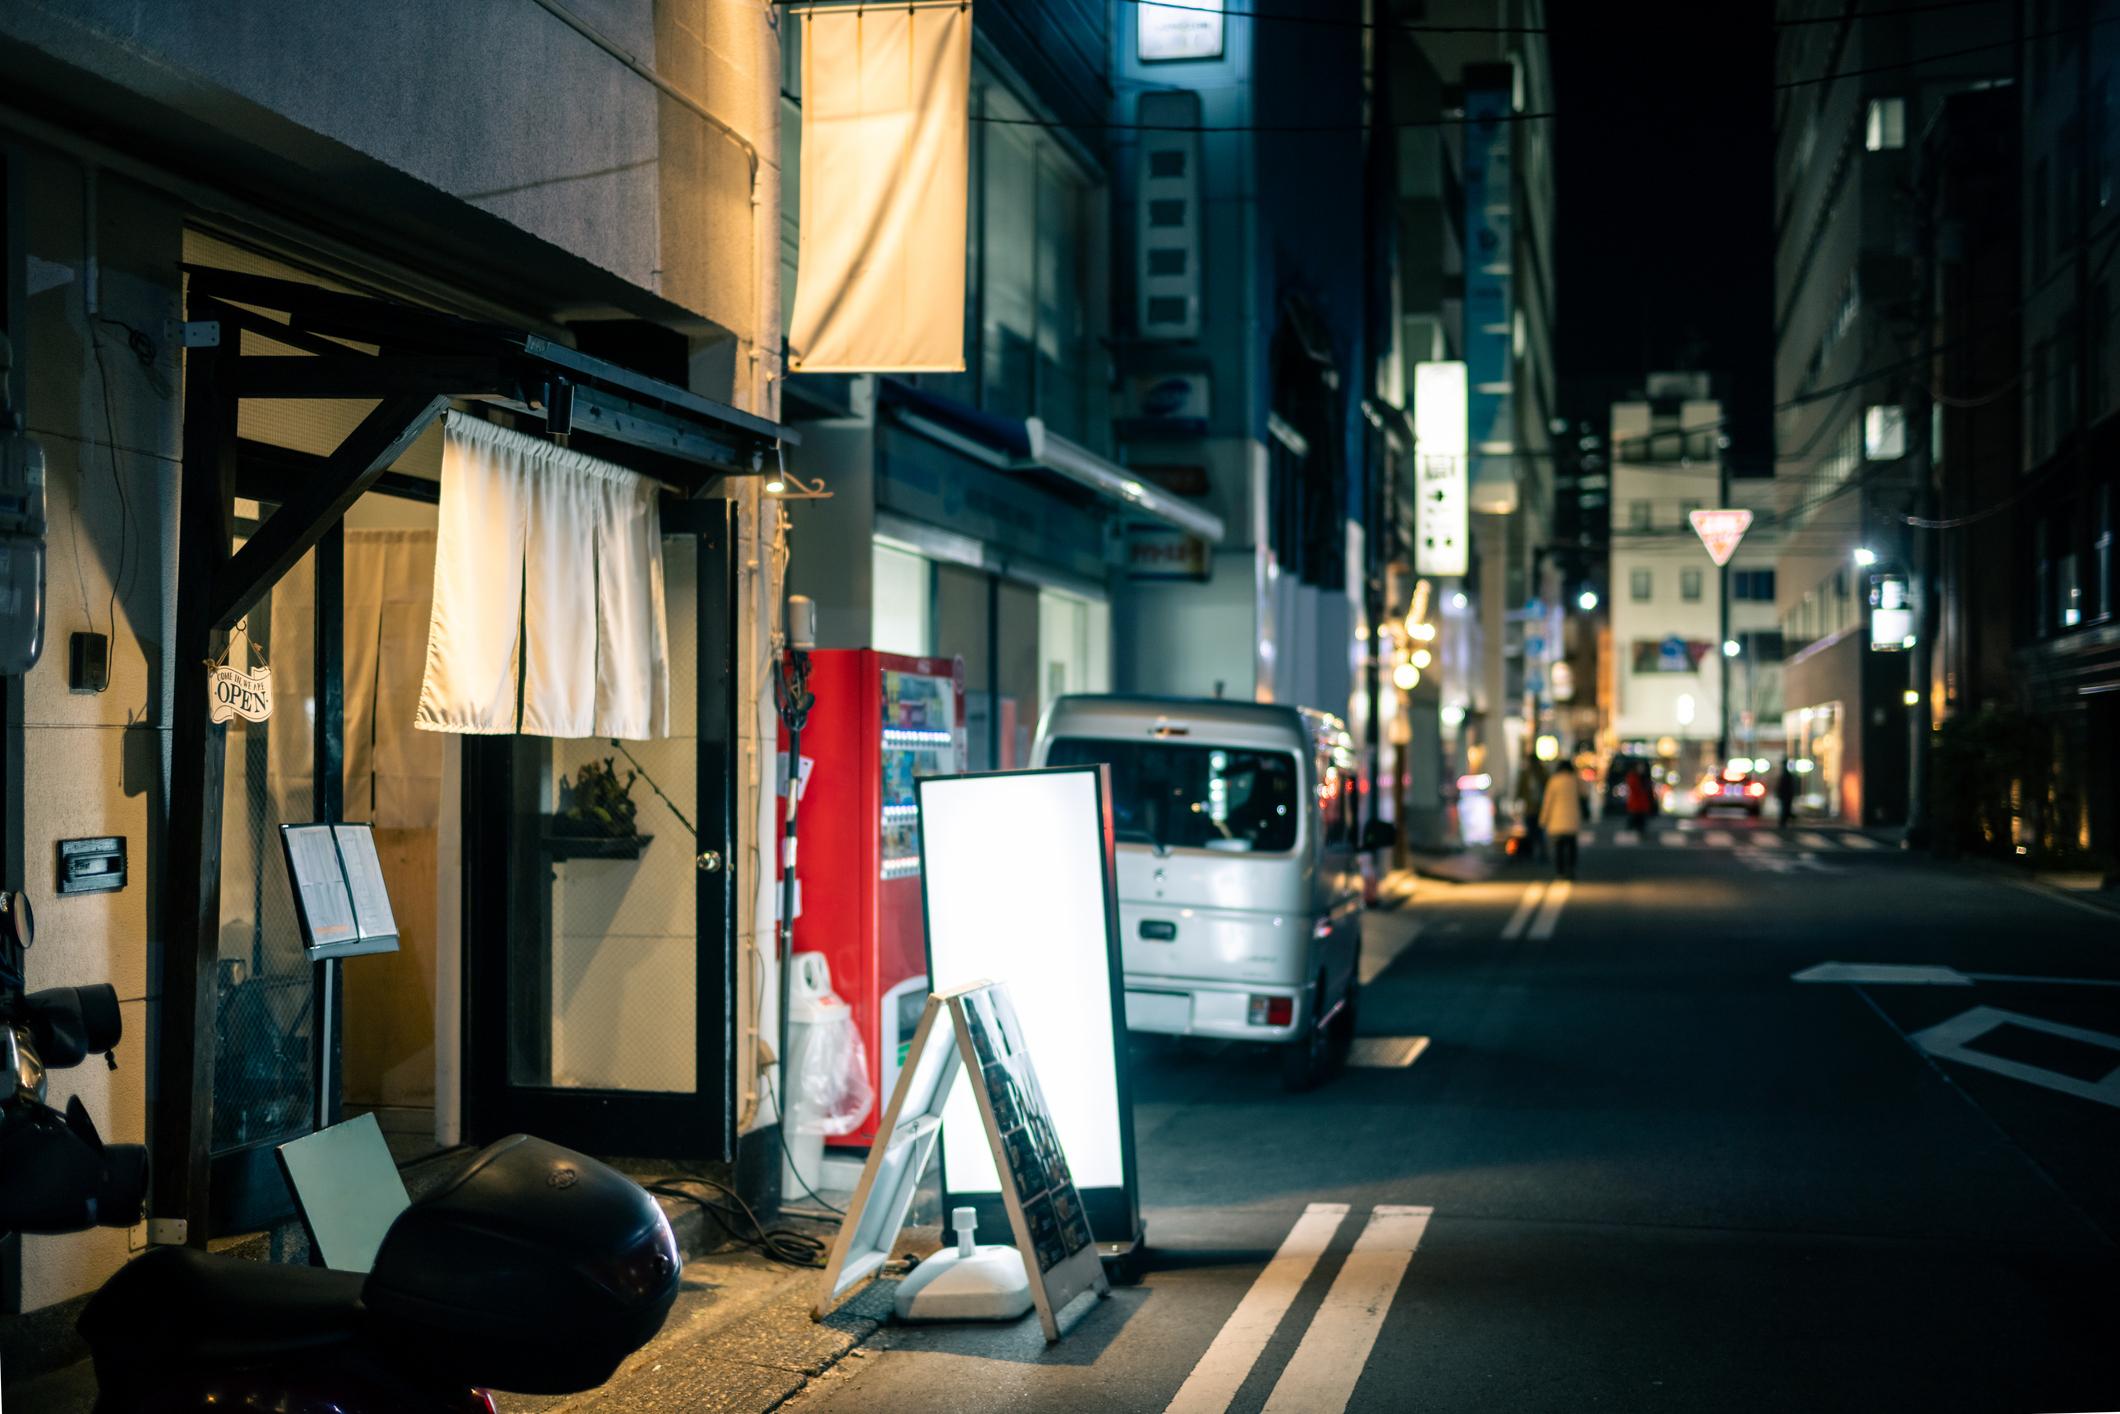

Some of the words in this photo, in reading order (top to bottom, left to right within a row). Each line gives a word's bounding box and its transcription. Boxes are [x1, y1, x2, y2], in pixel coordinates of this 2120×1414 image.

[217, 672, 232, 681] COME
[243, 680, 251, 690] WE
[253, 682, 265, 691] ARE
[217, 681, 266, 713] OPEN
